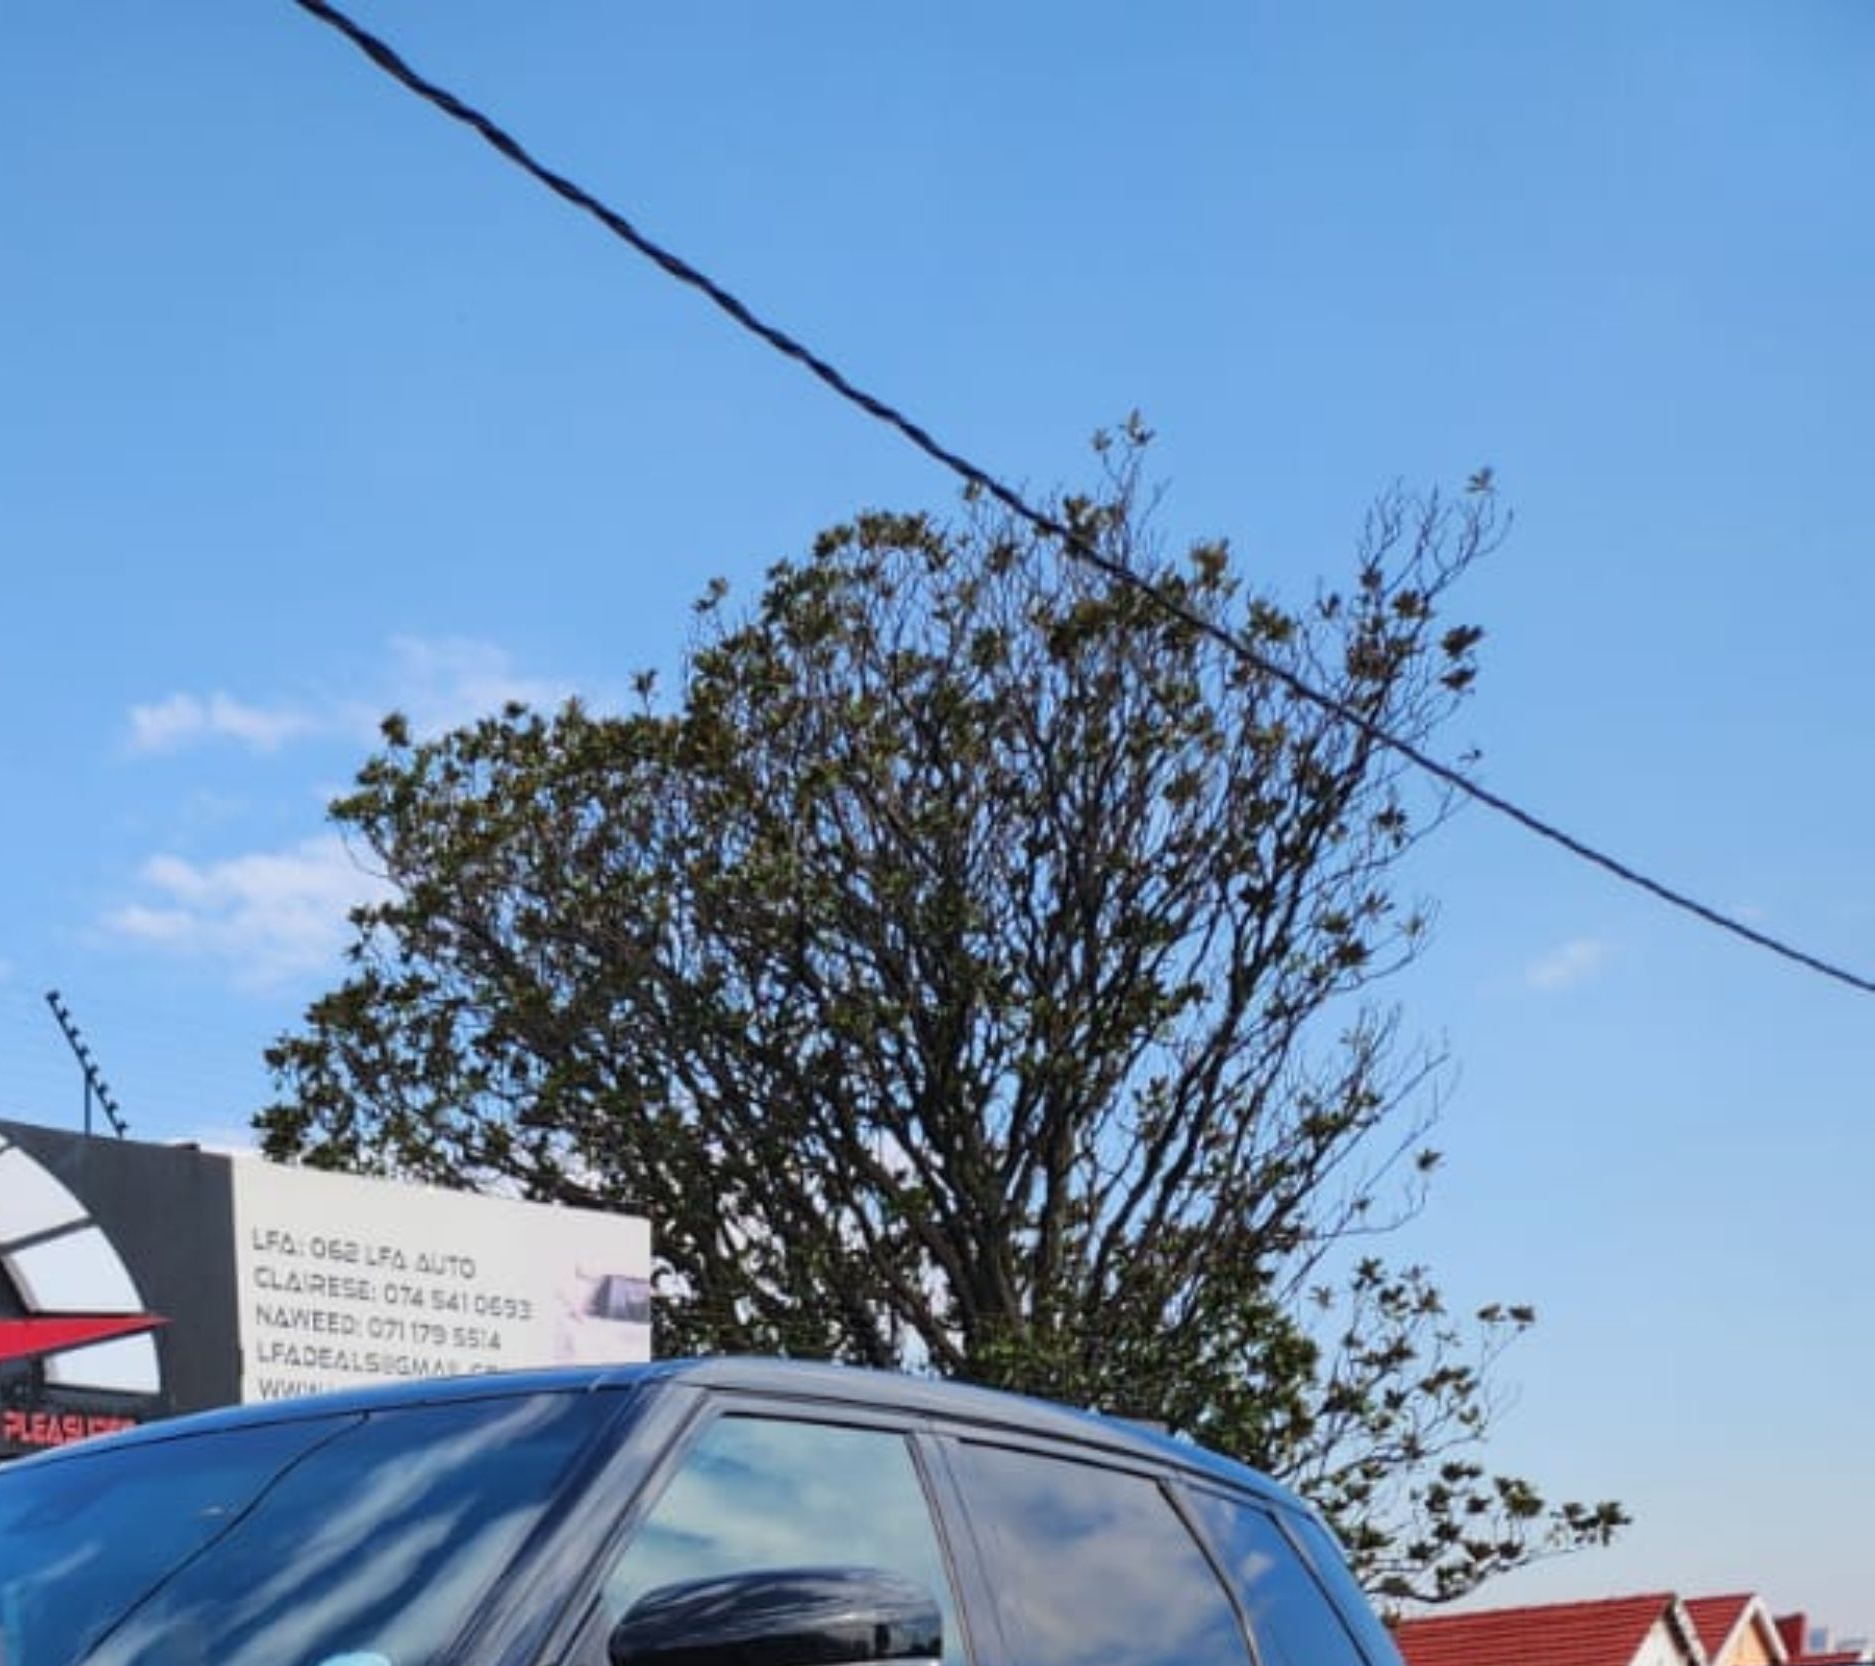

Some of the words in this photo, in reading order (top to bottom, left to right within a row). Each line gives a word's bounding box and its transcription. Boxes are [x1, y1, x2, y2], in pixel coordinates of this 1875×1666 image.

[252, 1226, 305, 1257] LFA:
[311, 1237, 359, 1263] 062
[366, 1244, 407, 1271] LFA
[415, 1252, 477, 1280] AUTO
[384, 1283, 424, 1307] 074
[368, 1316, 404, 1341] 071
